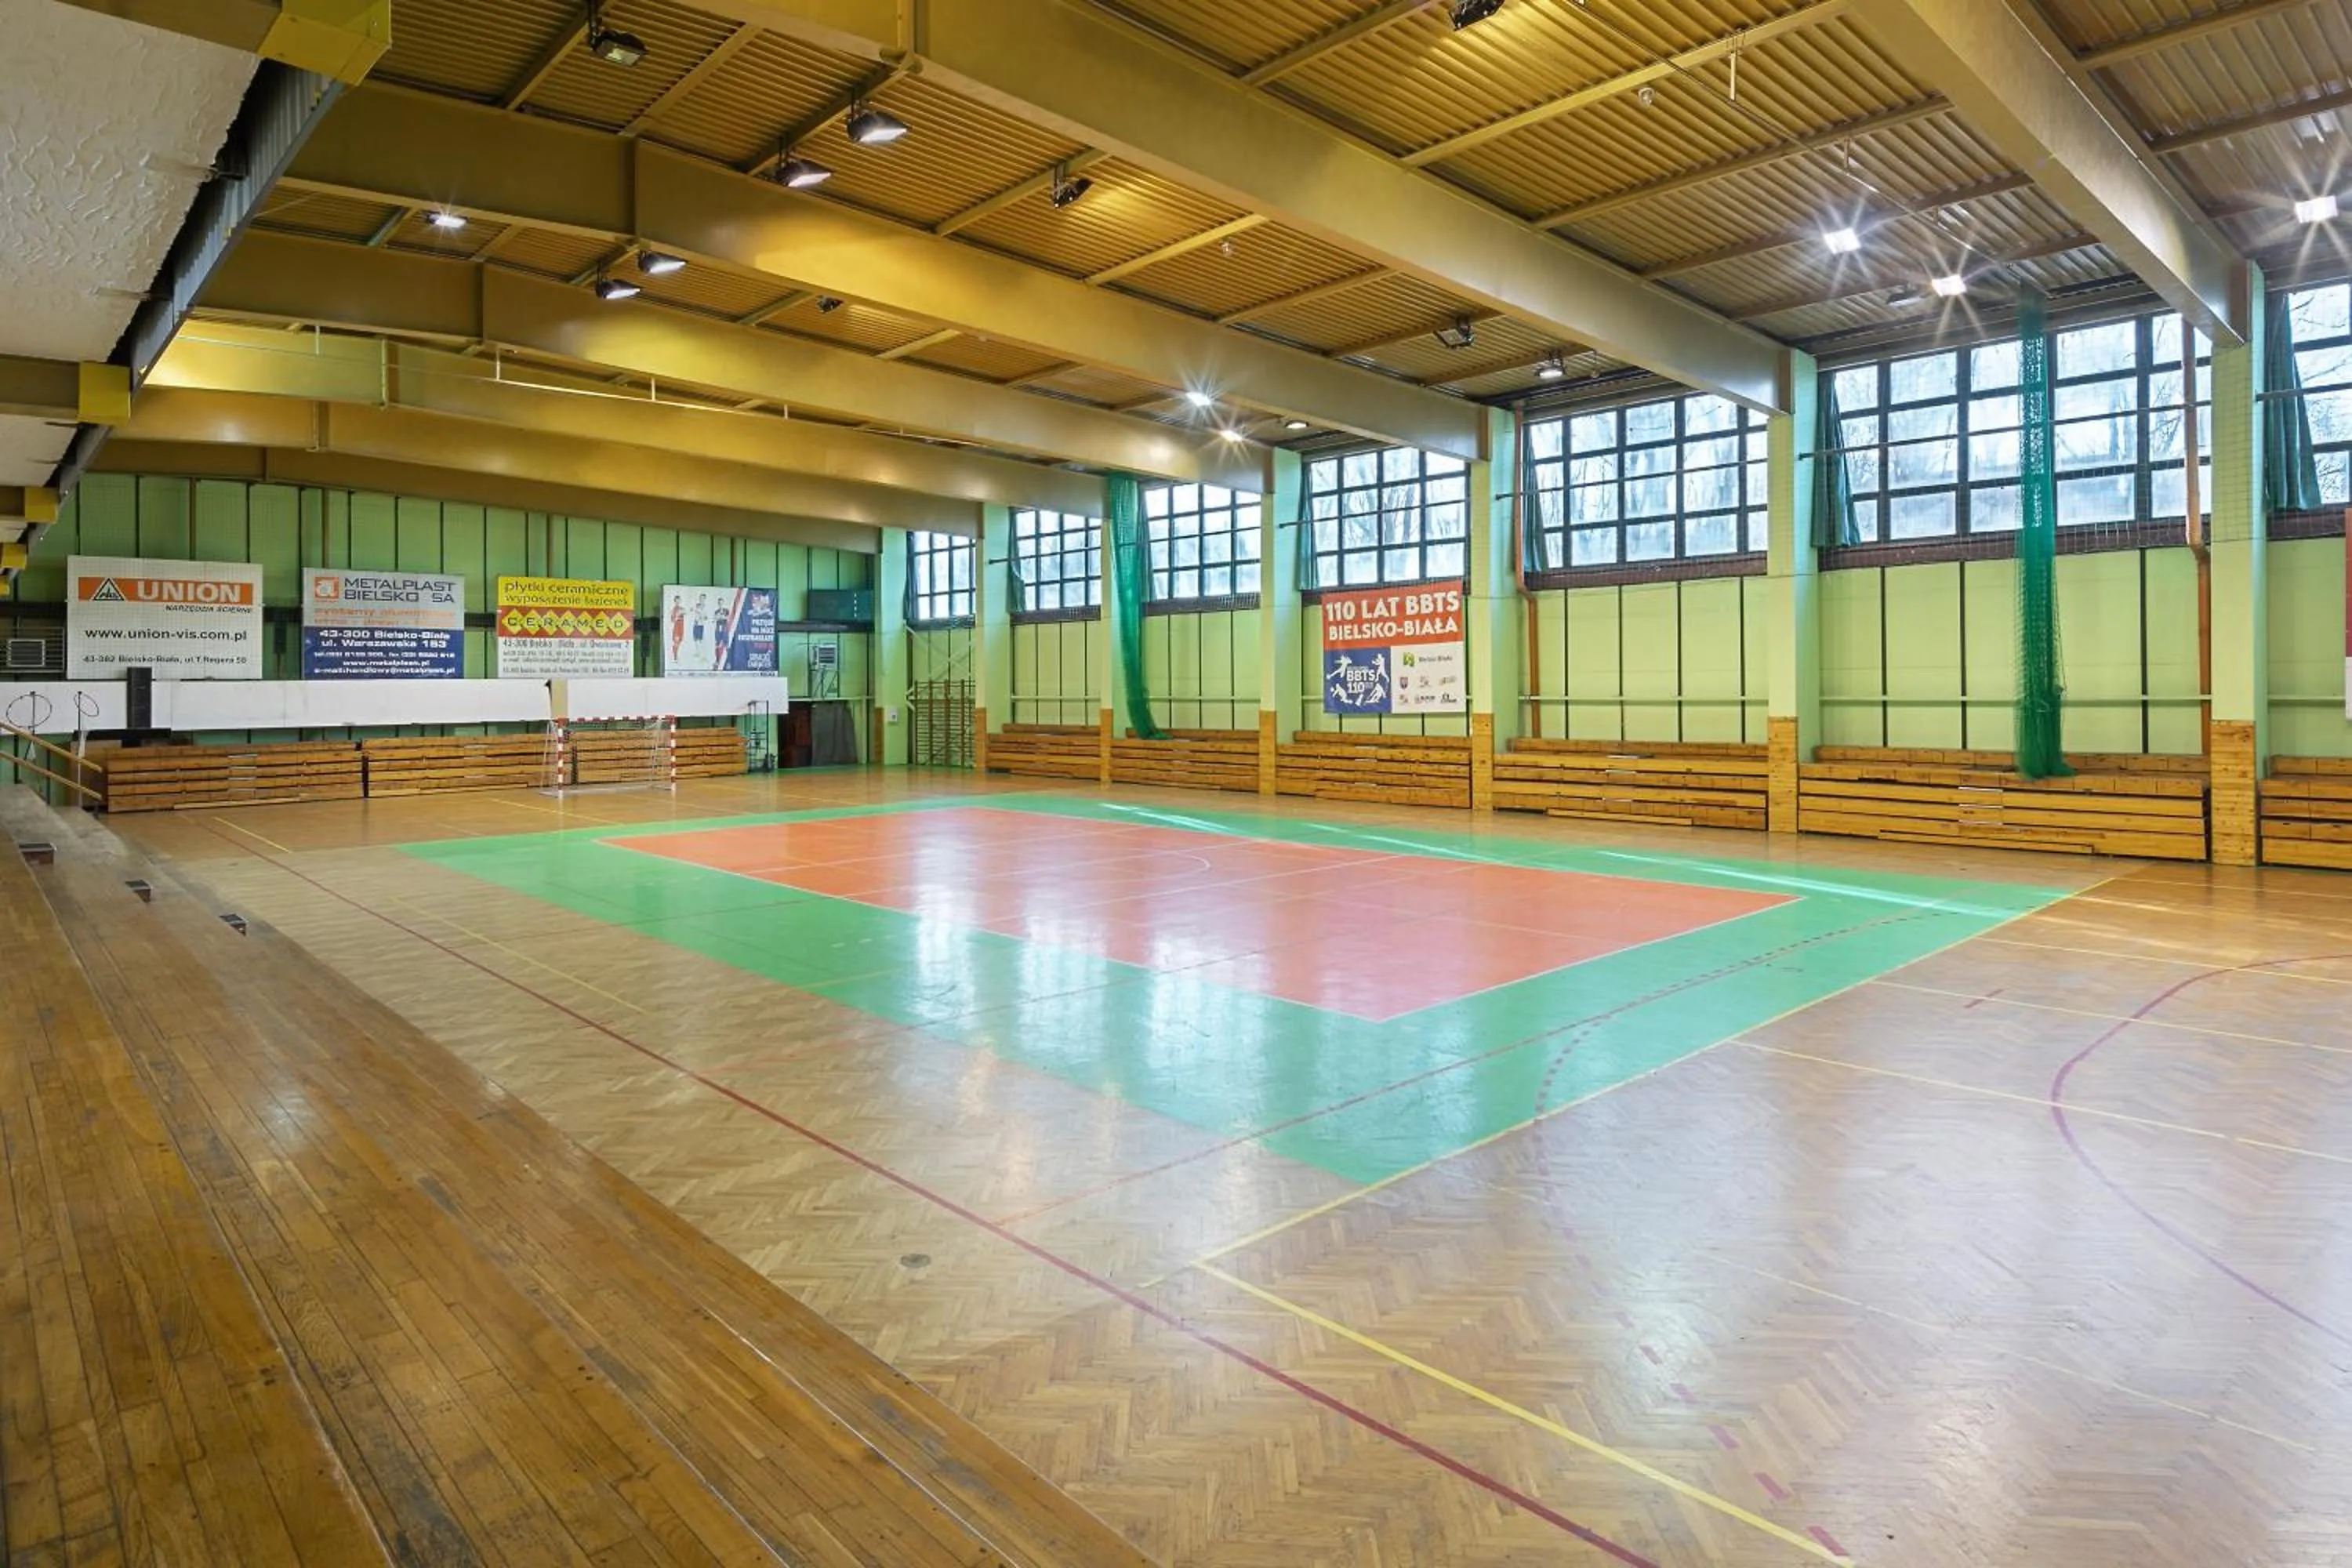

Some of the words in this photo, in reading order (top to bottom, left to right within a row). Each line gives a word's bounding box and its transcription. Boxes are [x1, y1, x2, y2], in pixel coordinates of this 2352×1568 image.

[137, 580, 241, 602] UNION
[343, 578, 456, 592] METALPLAST
[505, 580, 544, 593] płytki
[548, 583, 628, 596] ceramiczne
[343, 590, 420, 603] BIELSKO
[432, 592, 455, 603] SA
[505, 594, 581, 605] wyposażenie
[584, 596, 628, 606] łazienek
[1327, 601, 1356, 622] 110
[1361, 597, 1399, 619] LAT
[1405, 590, 1460, 616] BBTS
[506, 617, 624, 628] CERAMED
[1328, 616, 1458, 641] BIELSKO-BIAŁA
[85, 629, 247, 642] www.union-vis.com.pl
[319, 630, 371, 639] 43-300
[374, 630, 450, 640] Bielsko-Biała
[422, 640, 447, 648] 153
[1346, 669, 1376, 682] BBTS
[1346, 681, 1366, 695] 110
